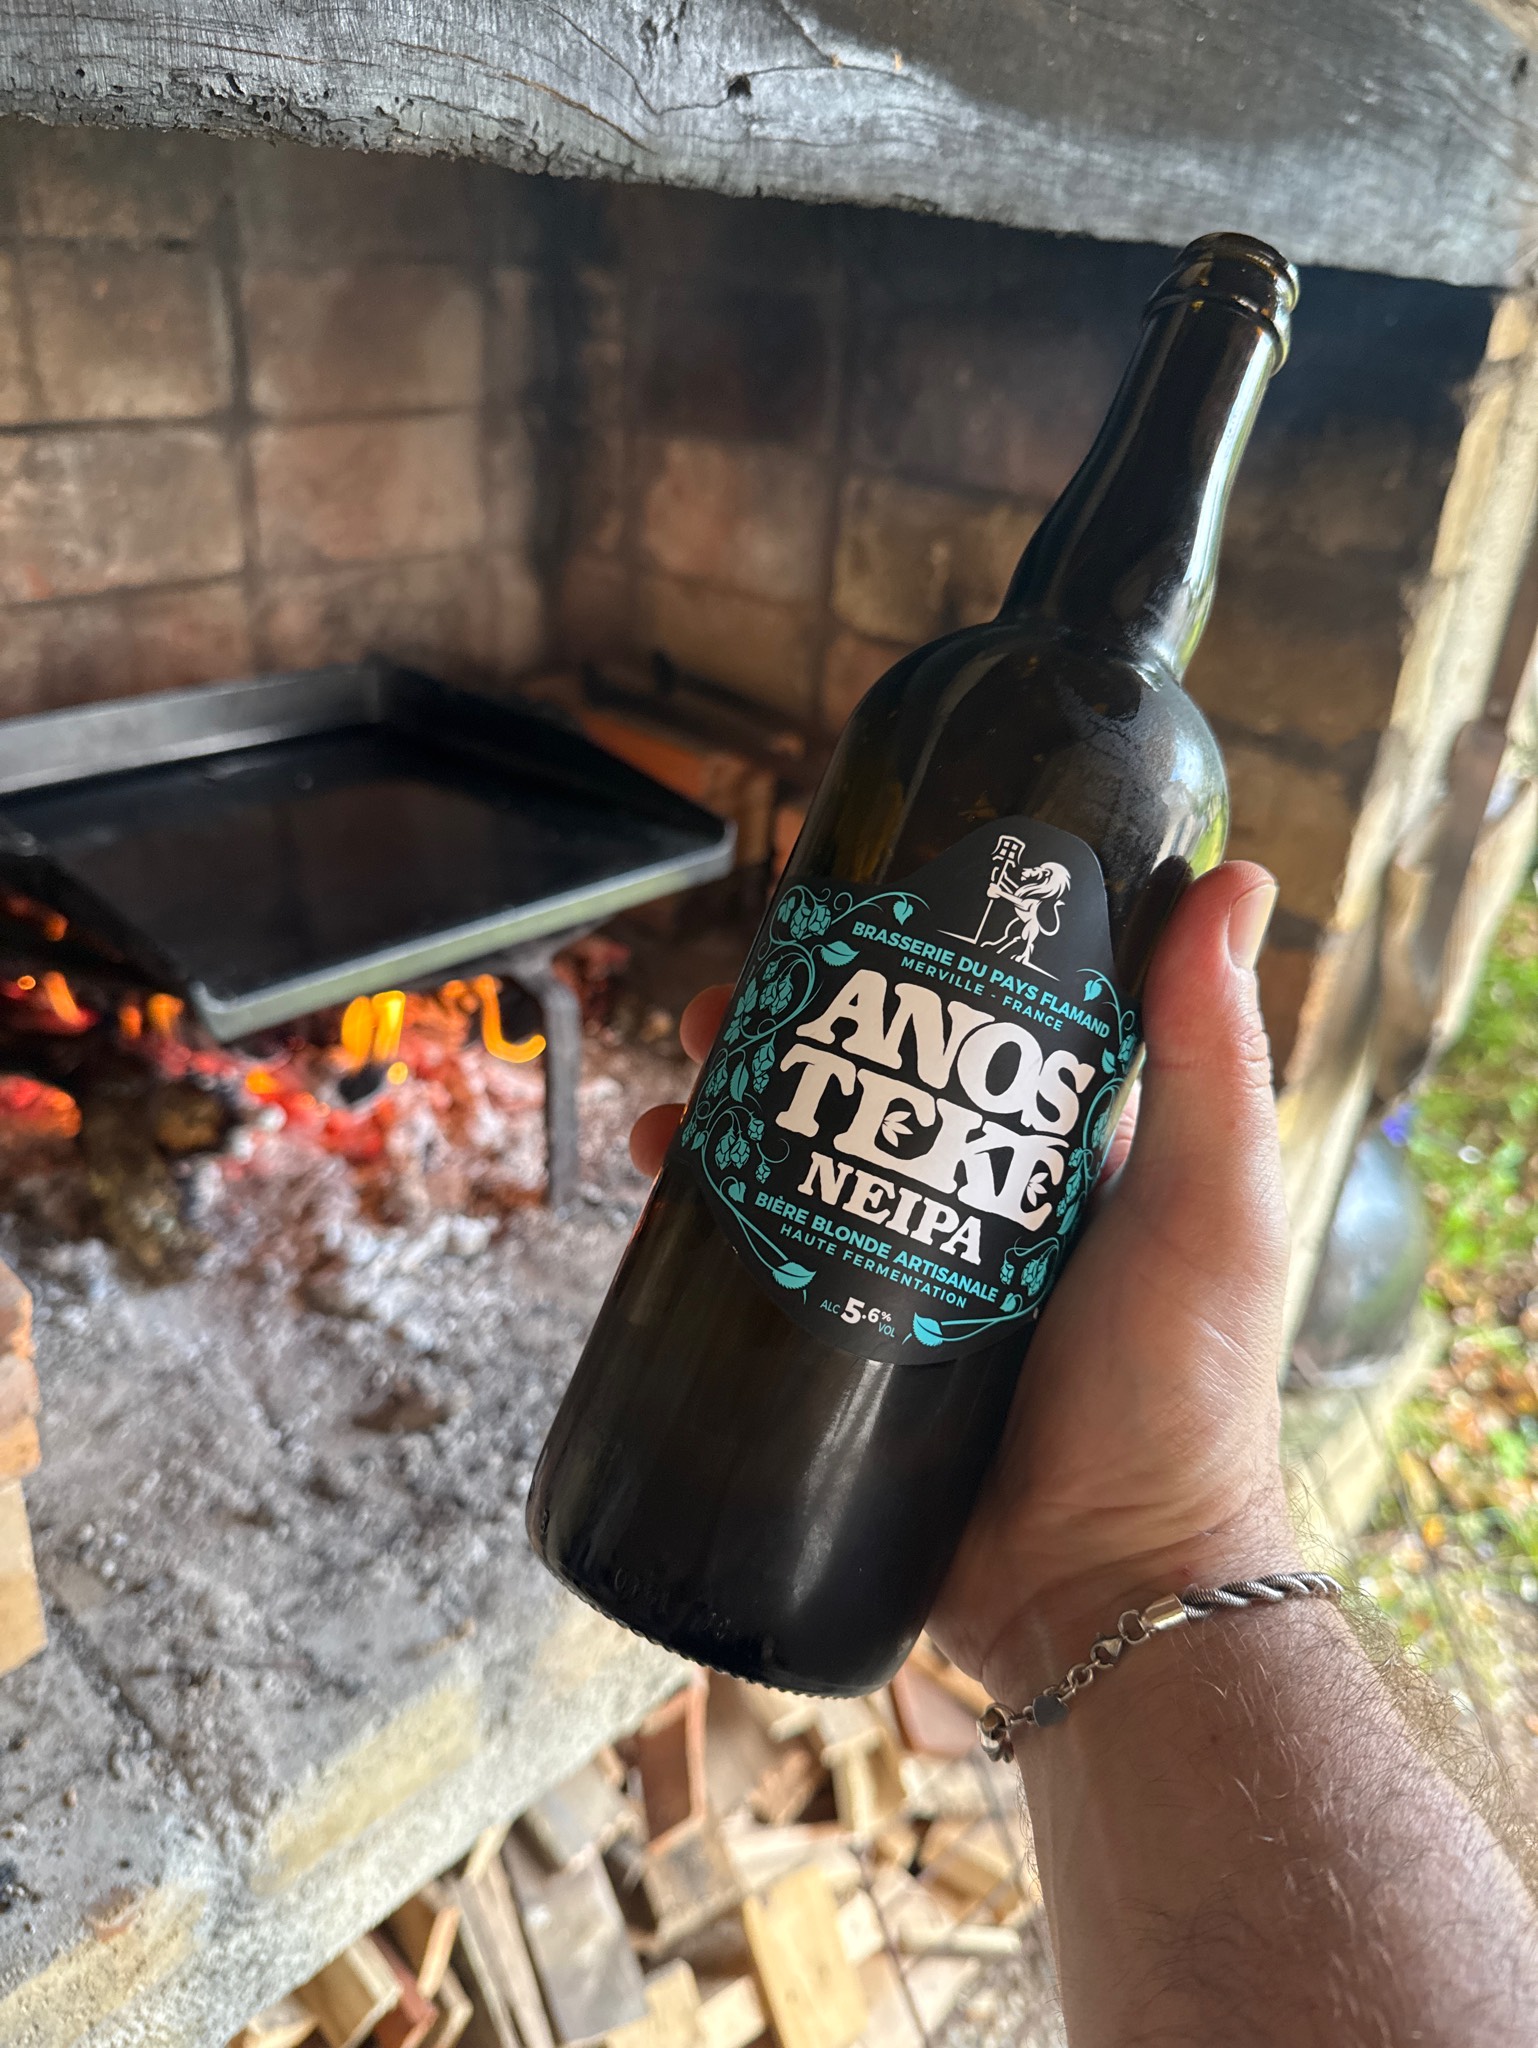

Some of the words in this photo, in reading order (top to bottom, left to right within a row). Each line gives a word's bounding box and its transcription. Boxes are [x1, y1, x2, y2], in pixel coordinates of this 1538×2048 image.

[852, 921, 956, 966] BRASSERIE
[957, 956, 987, 978] DU
[990, 969, 1040, 1001] PAYS
[1040, 991, 1110, 1039] FLAMAND
[901, 956, 985, 996] MERVILLE
[1002, 998, 1063, 1032] FRANCE
[796, 969, 1096, 1136] ANOS
[754, 1191, 810, 1225] BIÈRE
[810, 1215, 891, 1260] BLONDE
[893, 1250, 999, 1303] ARTISANALE
[797, 1151, 983, 1266] NEIPA
[780, 1223, 836, 1256] HAUTE
[842, 1250, 967, 1309] FERMENTATION
[820, 1299, 841, 1315] ALC
[878, 1322, 896, 1338] VOL
